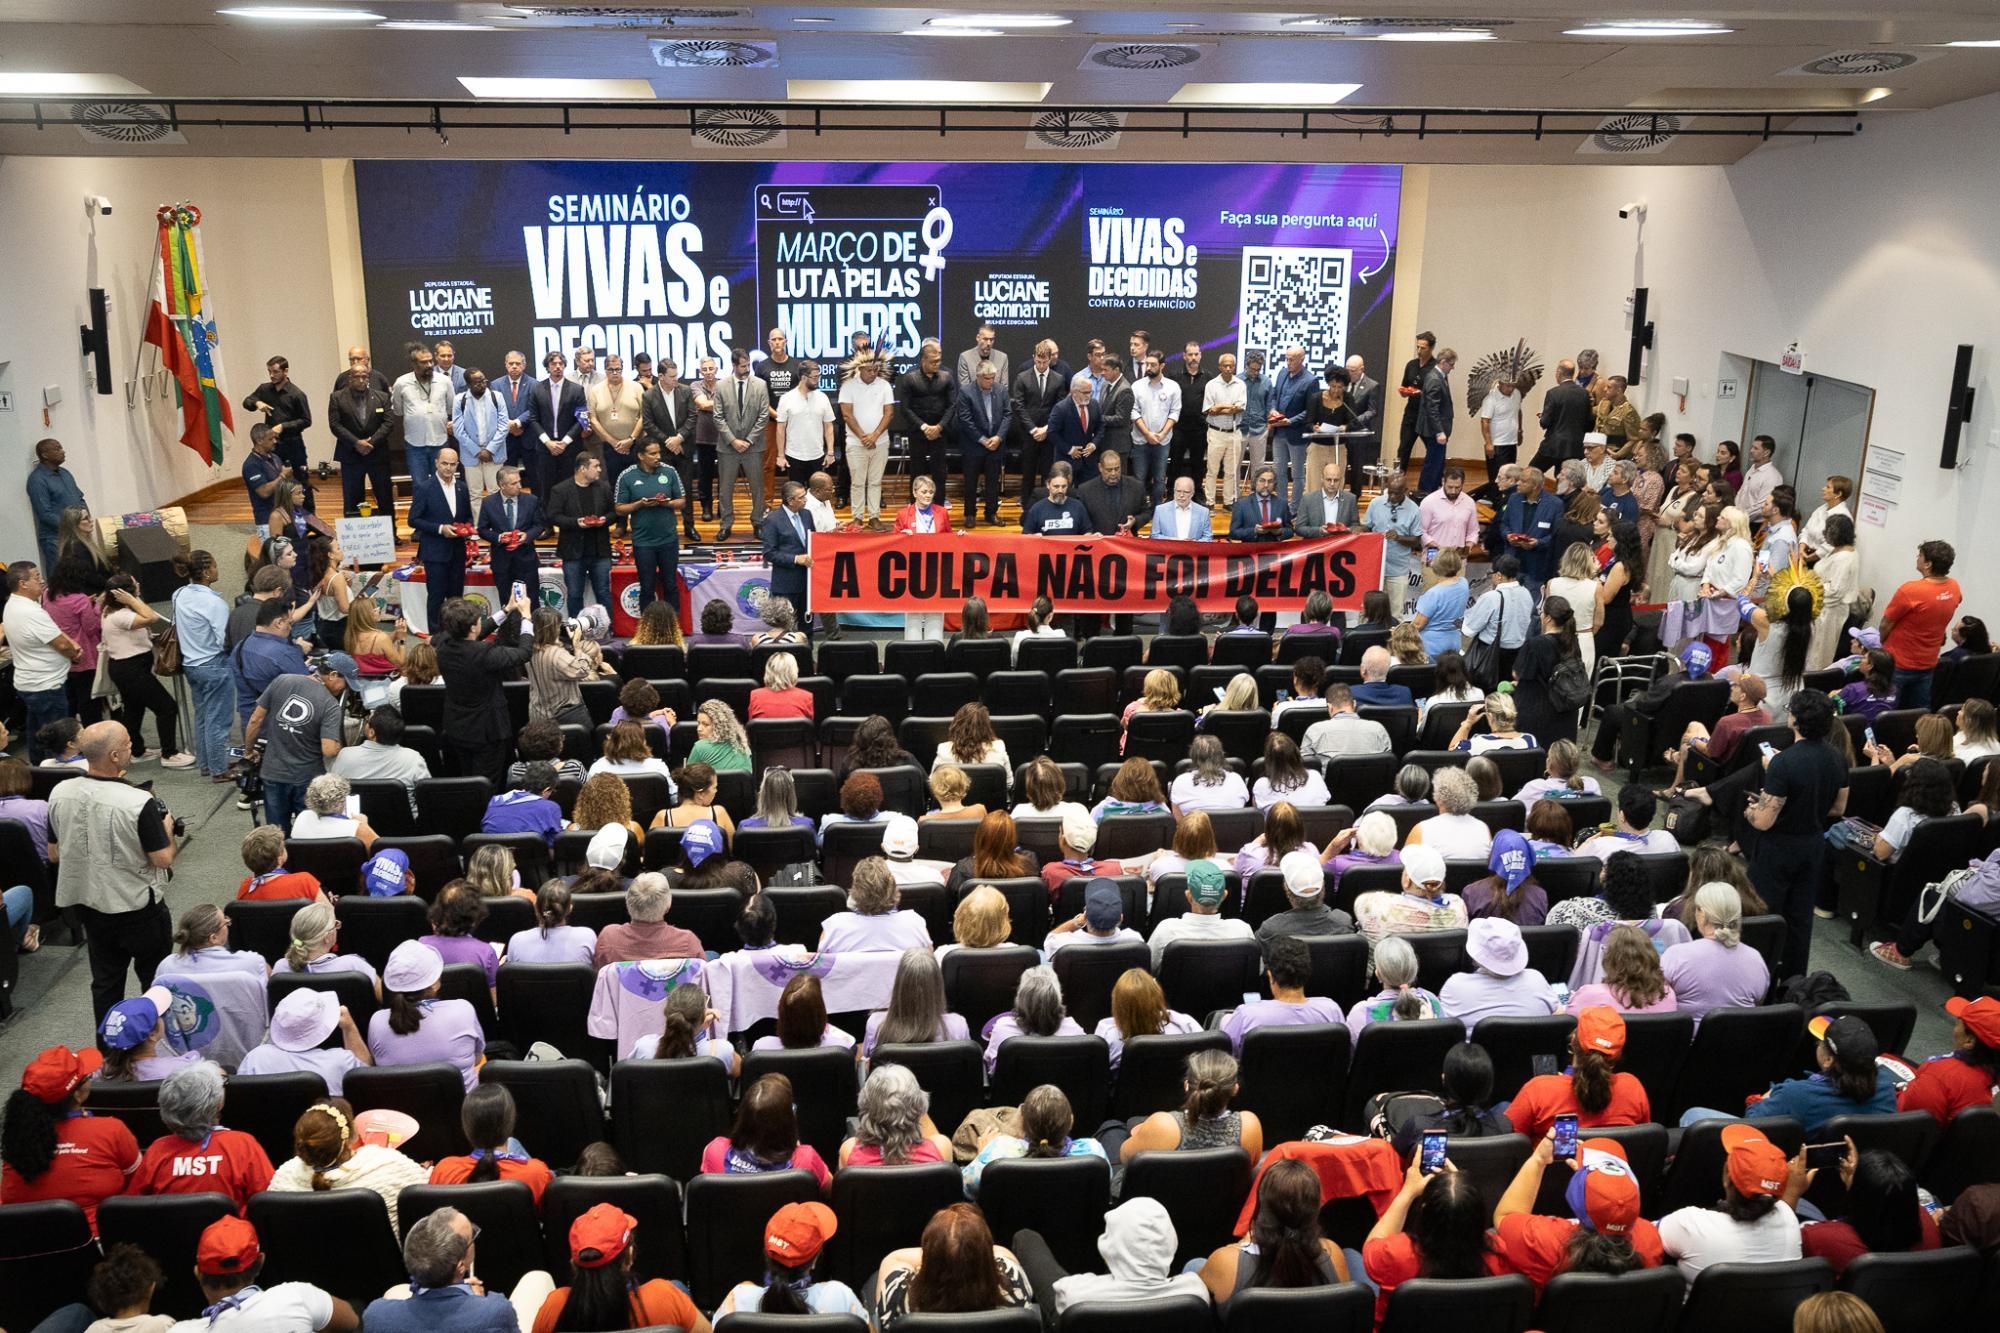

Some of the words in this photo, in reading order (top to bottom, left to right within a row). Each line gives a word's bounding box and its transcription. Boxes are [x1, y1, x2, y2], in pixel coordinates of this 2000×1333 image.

[549, 185, 690, 223] SEMINÁRIO
[1089, 206, 1124, 216] SEMINÁRIO
[1220, 210, 1251, 228] Faça
[1254, 213, 1278, 225] sua
[1281, 213, 1344, 229] pergunta
[1347, 212, 1378, 230] aqui
[777, 231, 878, 273] MARÇO
[883, 231, 917, 262] DE
[1089, 217, 1185, 266] VIVAS
[1185, 245, 1198, 266] e
[523, 221, 706, 319] VIVAS
[709, 275, 731, 317] e
[776, 268, 842, 298] LUTA
[845, 267, 921, 298] PELAS
[1088, 266, 1198, 298] DECIDIDAS
[409, 287, 493, 312] LUCIANE
[974, 280, 1050, 302] LUCIANE
[1088, 299, 1126, 308] CONTRA
[1128, 299, 1136, 308] O
[1138, 298, 1196, 310] FEMINICÍDIO
[777, 301, 922, 360] MULHERES
[829, 551, 860, 598] A
[877, 550, 1019, 599] CULPA
[1037, 544, 1128, 600] NÃO
[1143, 553, 1209, 600] FOI
[1225, 550, 1357, 599] DELAS
[172, 1155, 223, 1177] MST
[768, 1235, 790, 1250] MST
